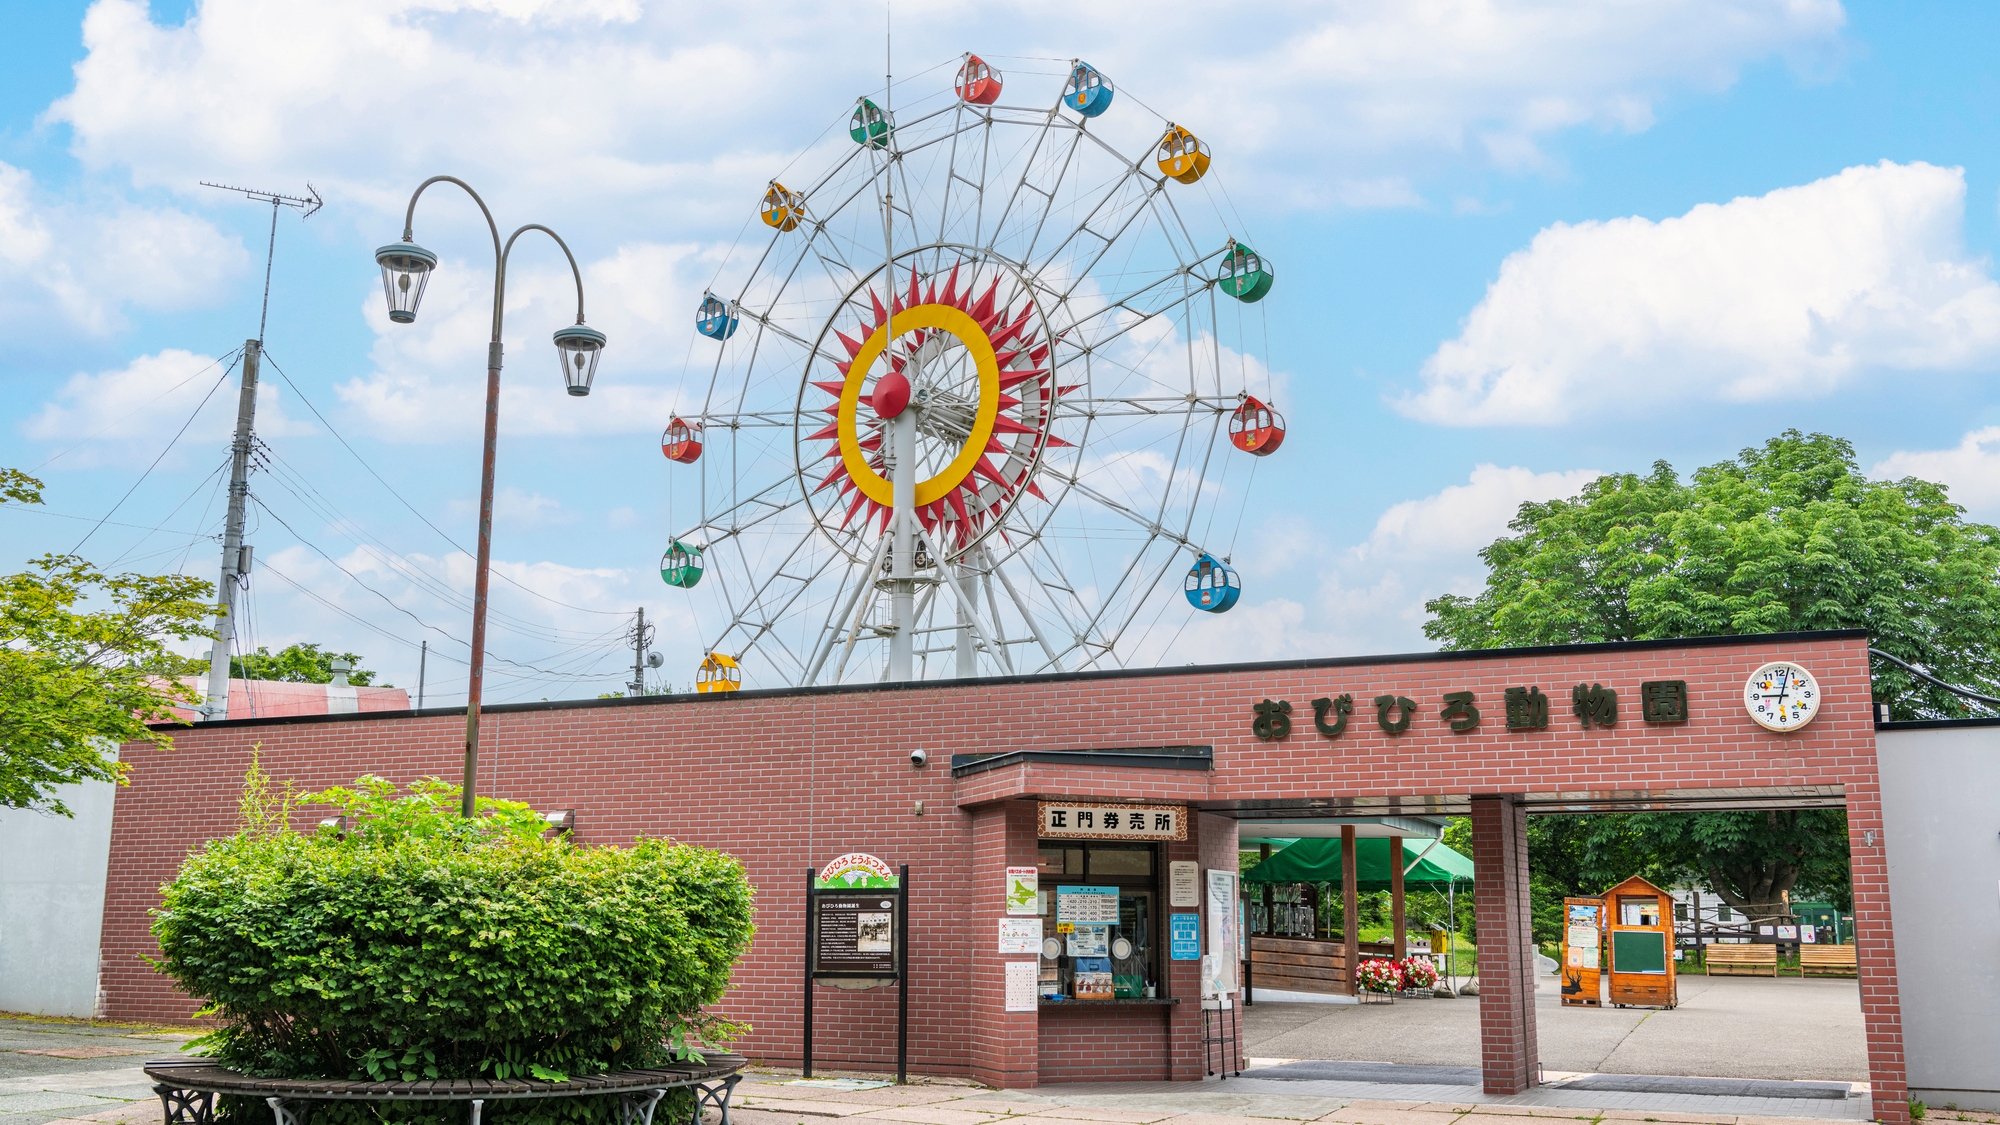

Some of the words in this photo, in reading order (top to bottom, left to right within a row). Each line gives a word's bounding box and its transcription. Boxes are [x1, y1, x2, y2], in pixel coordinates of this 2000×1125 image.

[1252, 680, 1689, 739] おびひろ動物園
[1051, 810, 1170, 831] 正門券売所
[822, 857, 848, 882] おびひろ
[850, 855, 890, 880] どうぶつえん
